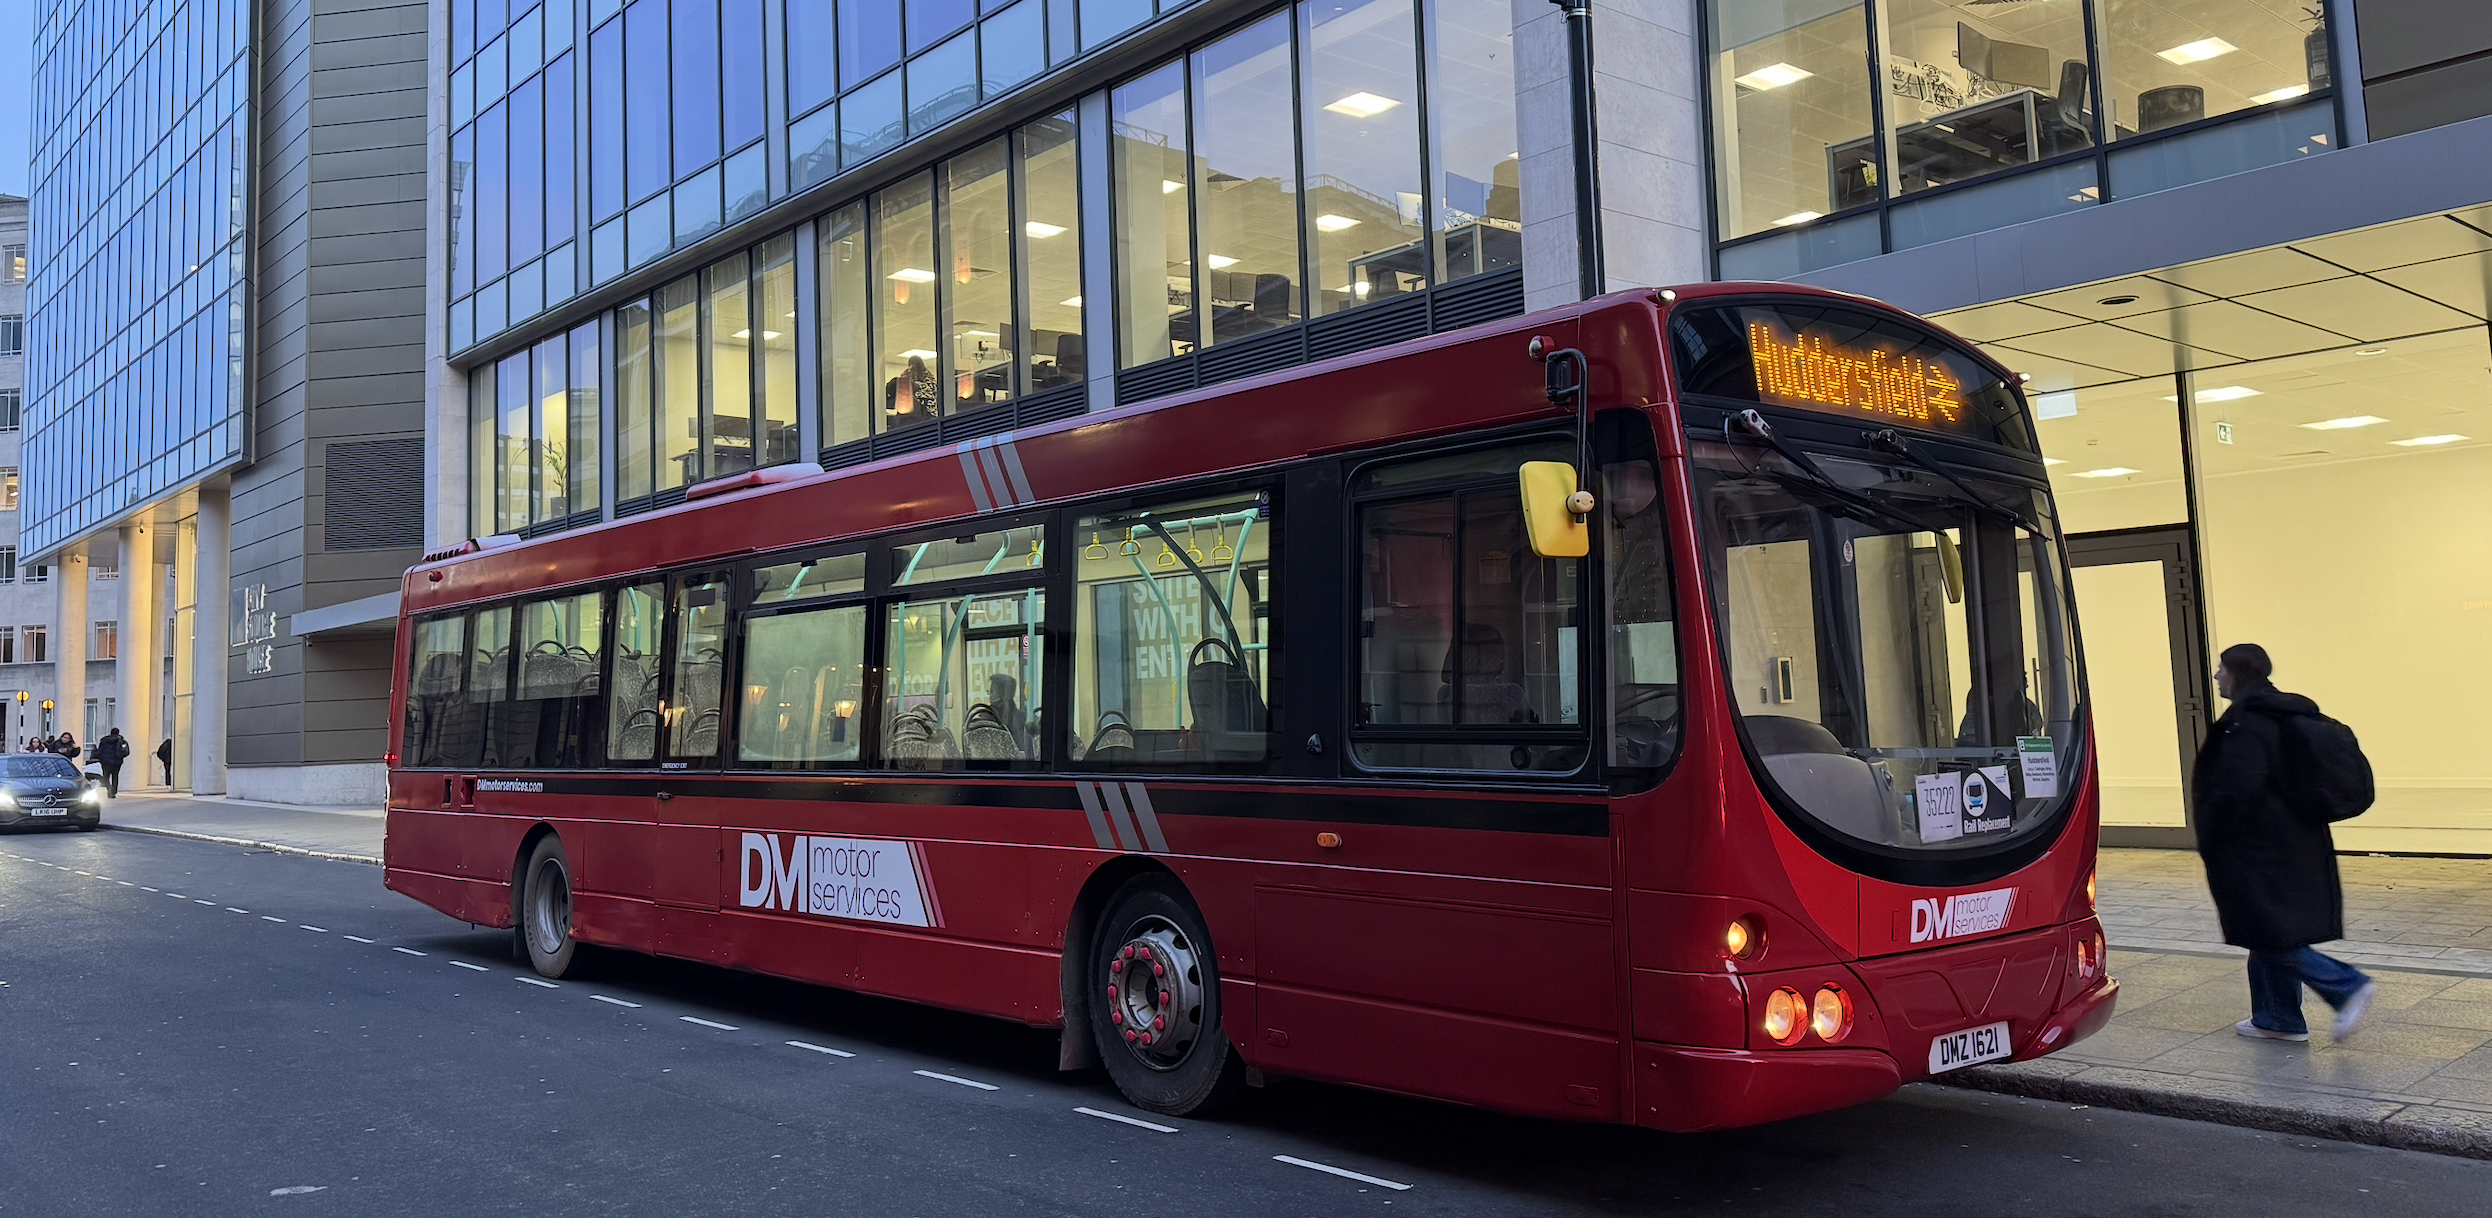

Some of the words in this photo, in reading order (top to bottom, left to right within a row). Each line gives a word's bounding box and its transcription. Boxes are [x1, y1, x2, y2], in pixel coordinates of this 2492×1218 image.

[1749, 322, 1929, 421] Huddersfield
[968, 598, 1012, 625] ACE
[477, 778, 544, 793] DMmotorservices.com
[1924, 786, 1955, 817] 35222
[1964, 818, 1977, 834] Rail
[1977, 815, 2011, 834] Replacement
[739, 832, 808, 913] DM
[813, 841, 881, 878] motor
[812, 882, 901, 919] services
[1910, 895, 1955, 943] DM
[1956, 894, 1992, 916] motor
[1954, 912, 2000, 935] services
[1940, 1033, 1969, 1066] DMZ
[1971, 1027, 1999, 1058] 1621
